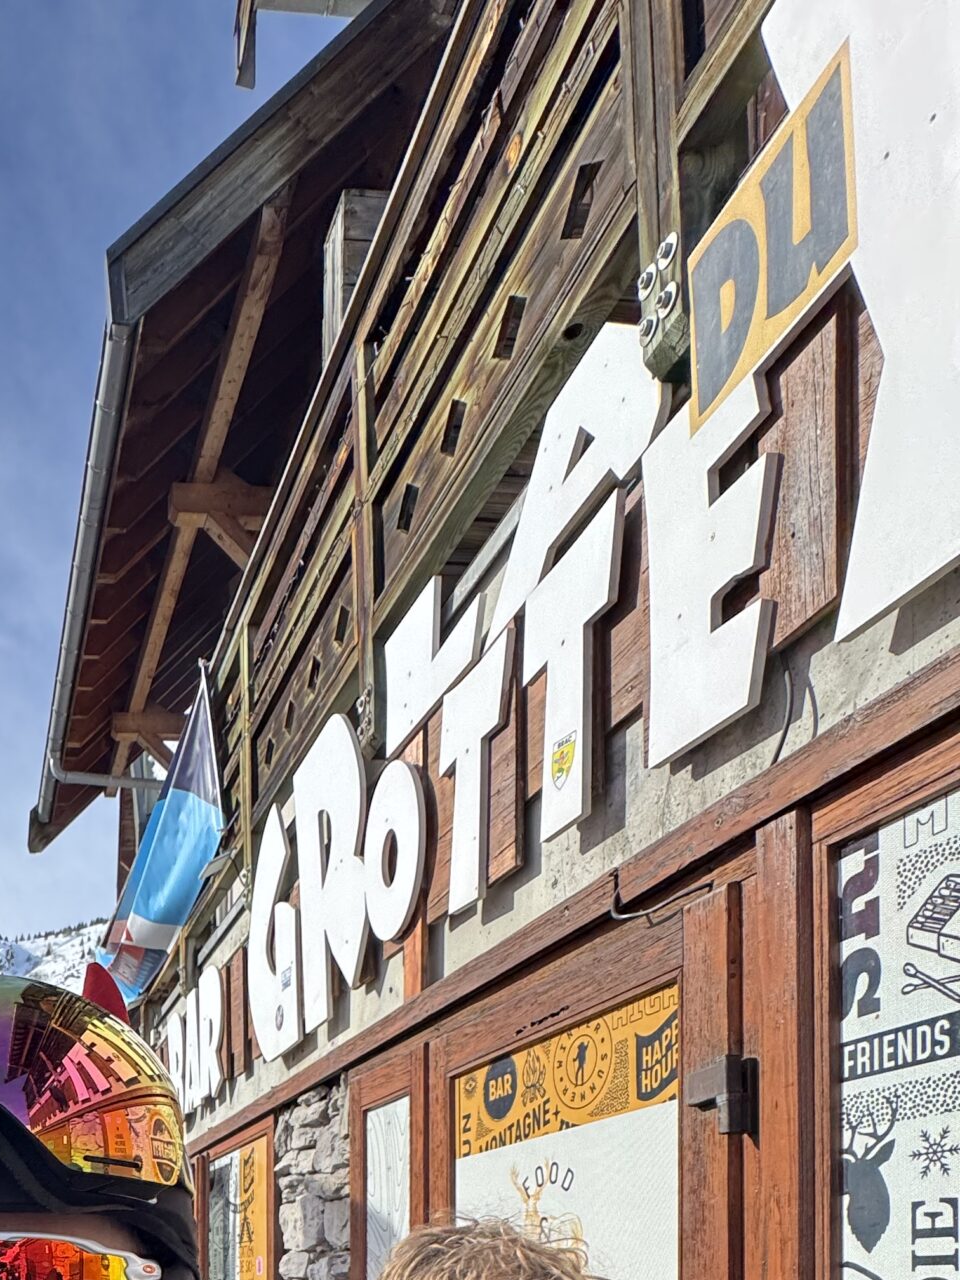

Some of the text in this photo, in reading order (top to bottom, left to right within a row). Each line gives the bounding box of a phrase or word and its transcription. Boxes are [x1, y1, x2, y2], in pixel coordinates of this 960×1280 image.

[167, 965, 223, 1113] BAR
[248, 369, 777, 1062] GROTTE
[691, 62, 849, 416] DU
[641, 1017, 678, 1069] HAPP
[843, 1019, 951, 1078] FRIENDS
[488, 1073, 512, 1102] BAR
[522, 1161, 575, 1199] FOOD
